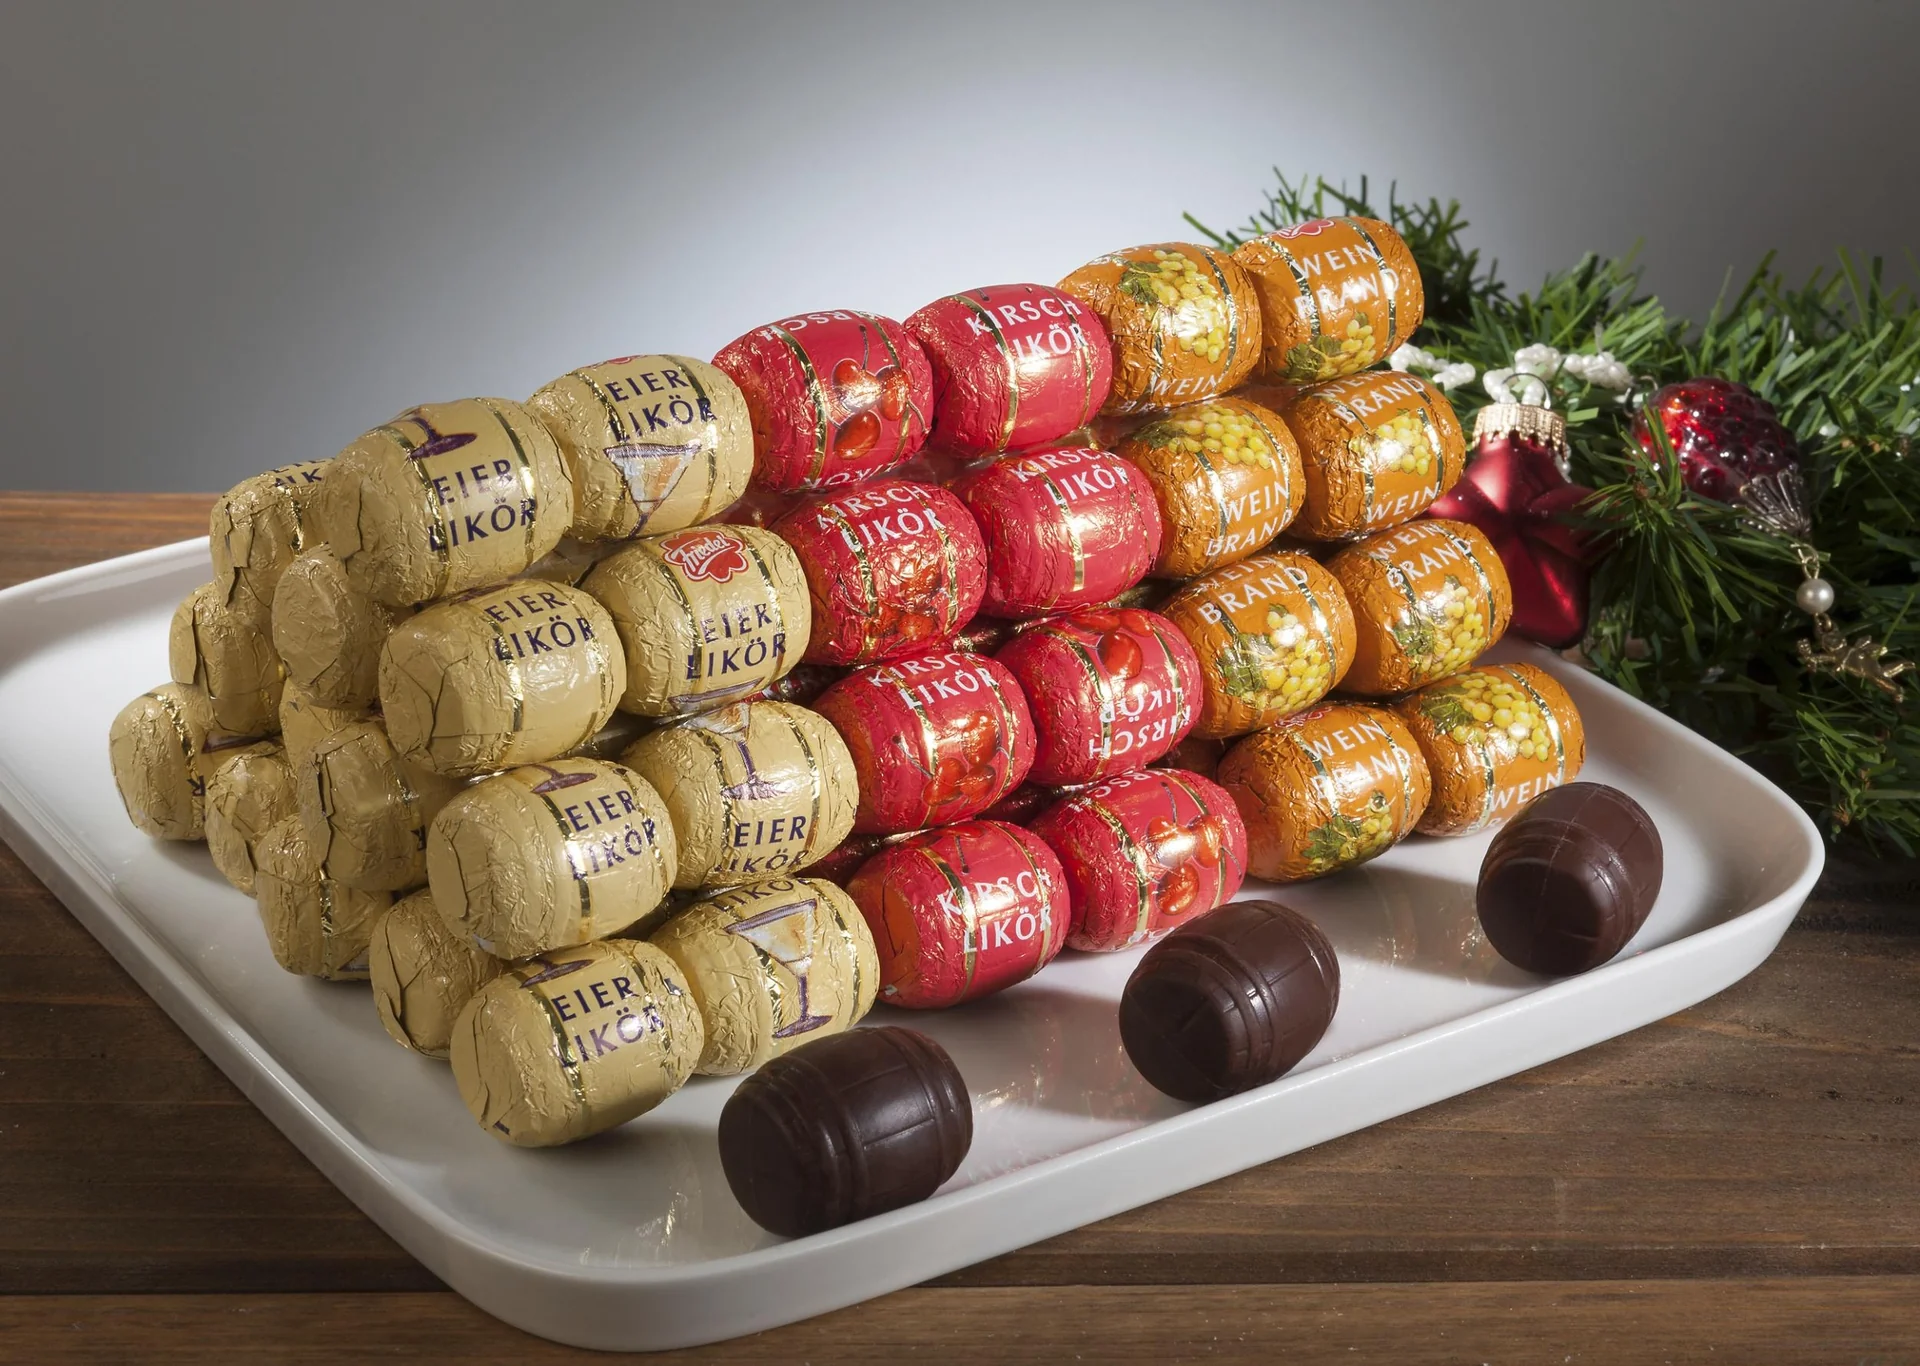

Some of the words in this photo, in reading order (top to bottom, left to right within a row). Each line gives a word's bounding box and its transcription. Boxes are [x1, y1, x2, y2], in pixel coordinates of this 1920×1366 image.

[1290, 240, 1383, 279] WEIN
[1294, 268, 1399, 319] BRAND
[965, 298, 1082, 336] KIRSCH
[605, 369, 689, 402] EIER
[1150, 371, 1229, 396] WEIN
[1333, 377, 1425, 424] BRAND
[609, 392, 717, 442] LIKÖR
[432, 459, 513, 506] EIER
[1008, 447, 1121, 483] KIRSCH
[1044, 464, 1129, 506] LIKÖR
[817, 485, 931, 530] KIRSCH
[1220, 481, 1290, 524] WEIN
[1366, 481, 1440, 523] WEIN
[427, 498, 538, 552] LIKÖR
[840, 508, 946, 552] LIKÖR
[1206, 509, 1292, 556] BRAND
[1369, 523, 1446, 561] WEIN
[1387, 538, 1472, 588] BRAND
[484, 592, 568, 623] EIER
[1198, 567, 1308, 625] BRAND
[493, 615, 597, 661] LIKÖR
[701, 603, 772, 644] EIER
[686, 633, 786, 680] LIKÖR
[899, 667, 999, 709] LIKÖR
[1307, 721, 1386, 762] WEIN
[1310, 746, 1412, 801] BRAND
[1489, 772, 1564, 813] WEIN
[564, 790, 637, 832] EIER
[734, 816, 807, 848] EIER
[937, 868, 1052, 920] KIRSCH
[963, 906, 1052, 954] LIKÖR
[551, 976, 640, 1022] EIER
